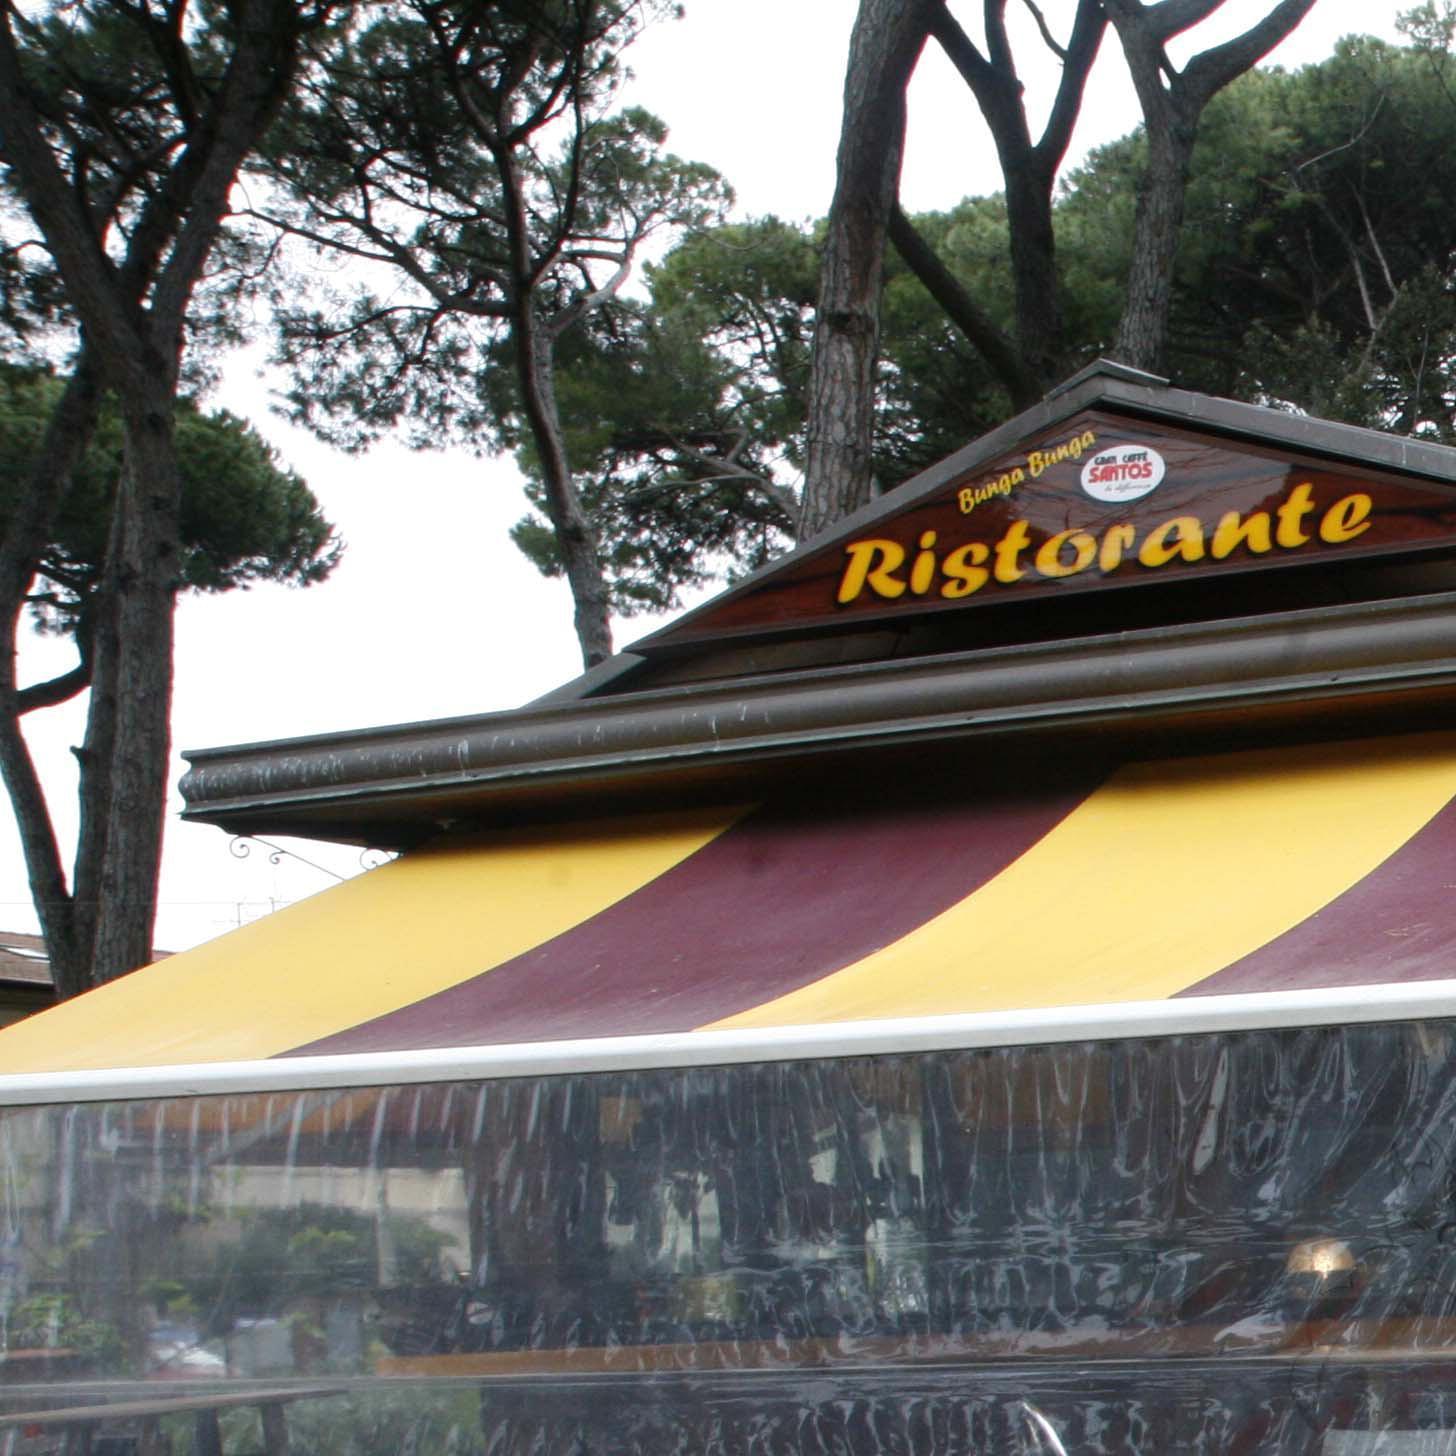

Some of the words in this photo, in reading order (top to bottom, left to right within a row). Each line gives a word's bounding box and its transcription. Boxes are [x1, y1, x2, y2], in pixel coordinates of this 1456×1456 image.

[957, 468, 1024, 515] Bunga
[1027, 429, 1097, 478] Bunga
[1088, 462, 1152, 483] SANTOS
[837, 482, 1374, 604] Ristorante
